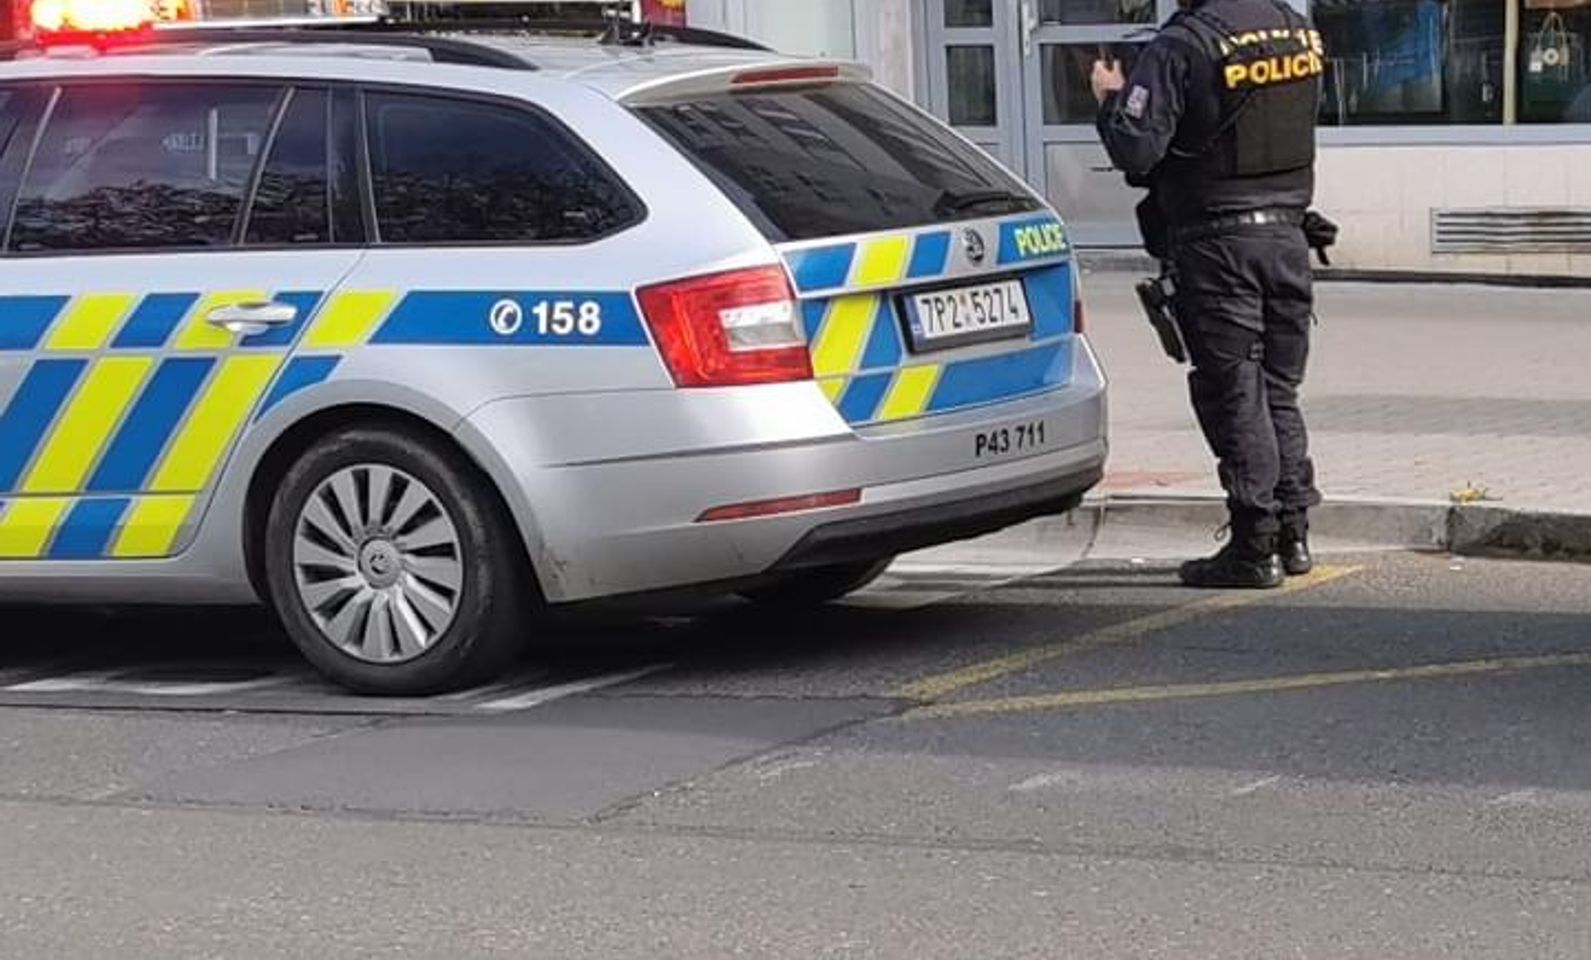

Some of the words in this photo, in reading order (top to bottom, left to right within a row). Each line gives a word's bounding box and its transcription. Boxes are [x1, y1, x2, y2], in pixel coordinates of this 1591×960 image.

[532, 300, 601, 336] 158
[975, 428, 1010, 457] P43
[1015, 420, 1045, 450] 711
